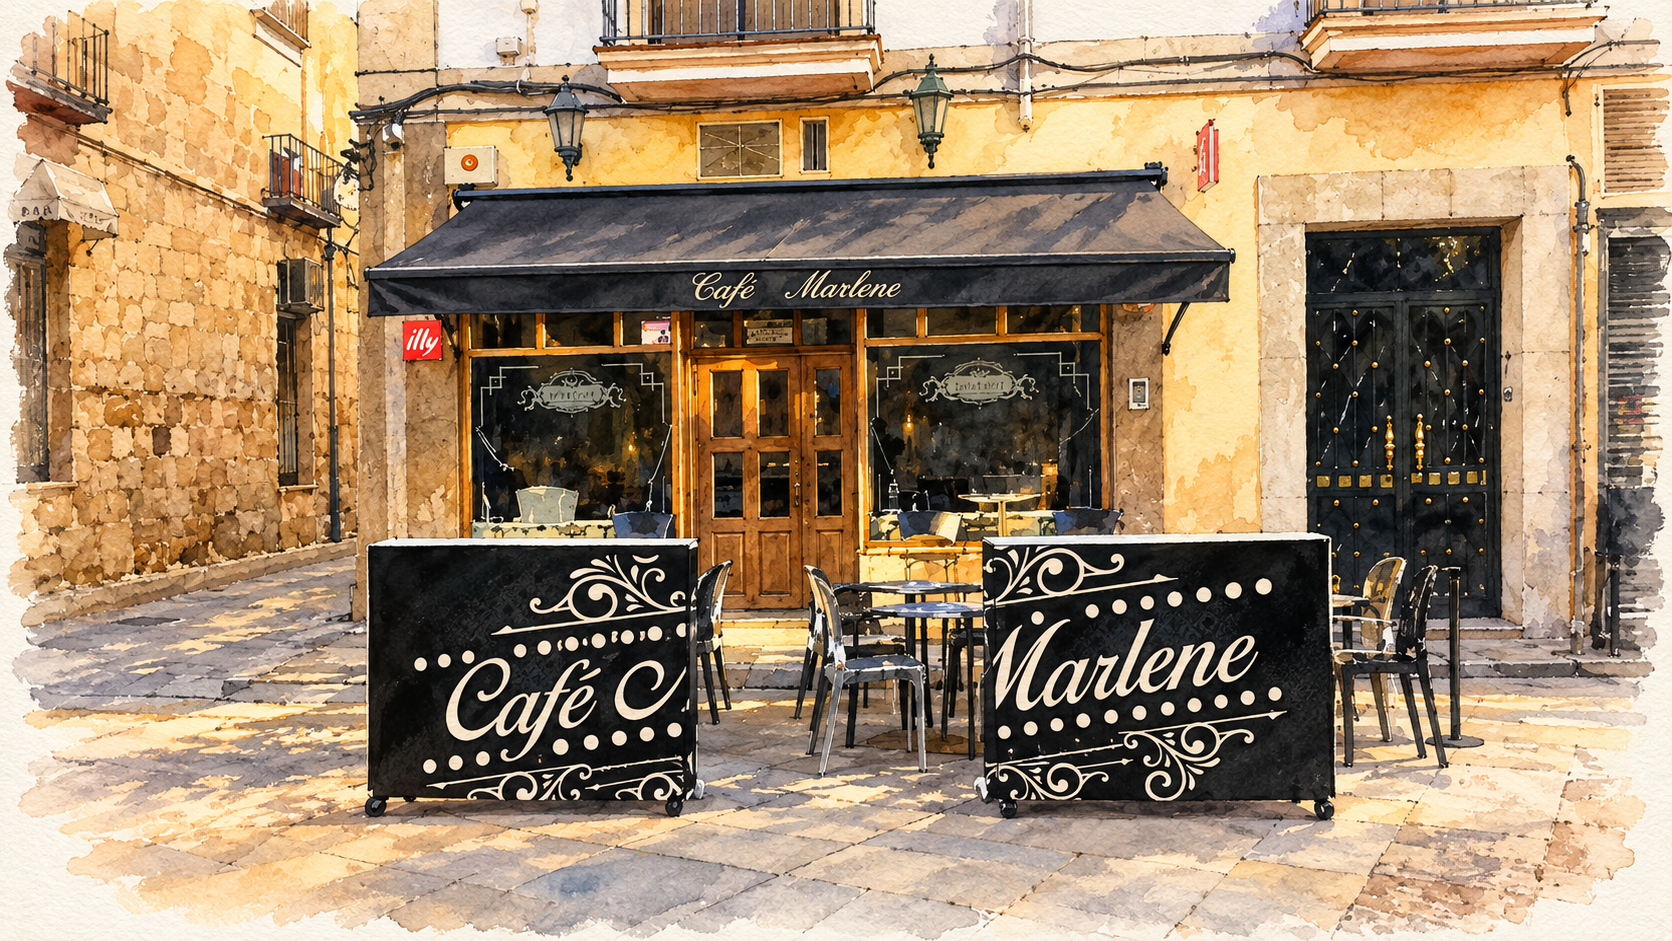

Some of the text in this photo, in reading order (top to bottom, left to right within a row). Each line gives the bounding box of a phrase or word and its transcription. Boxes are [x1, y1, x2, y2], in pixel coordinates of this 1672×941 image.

[691, 269, 902, 309] Café Marlene
[406, 327, 439, 357] illy
[992, 618, 1259, 712] Marlene
[445, 657, 602, 762] Café
